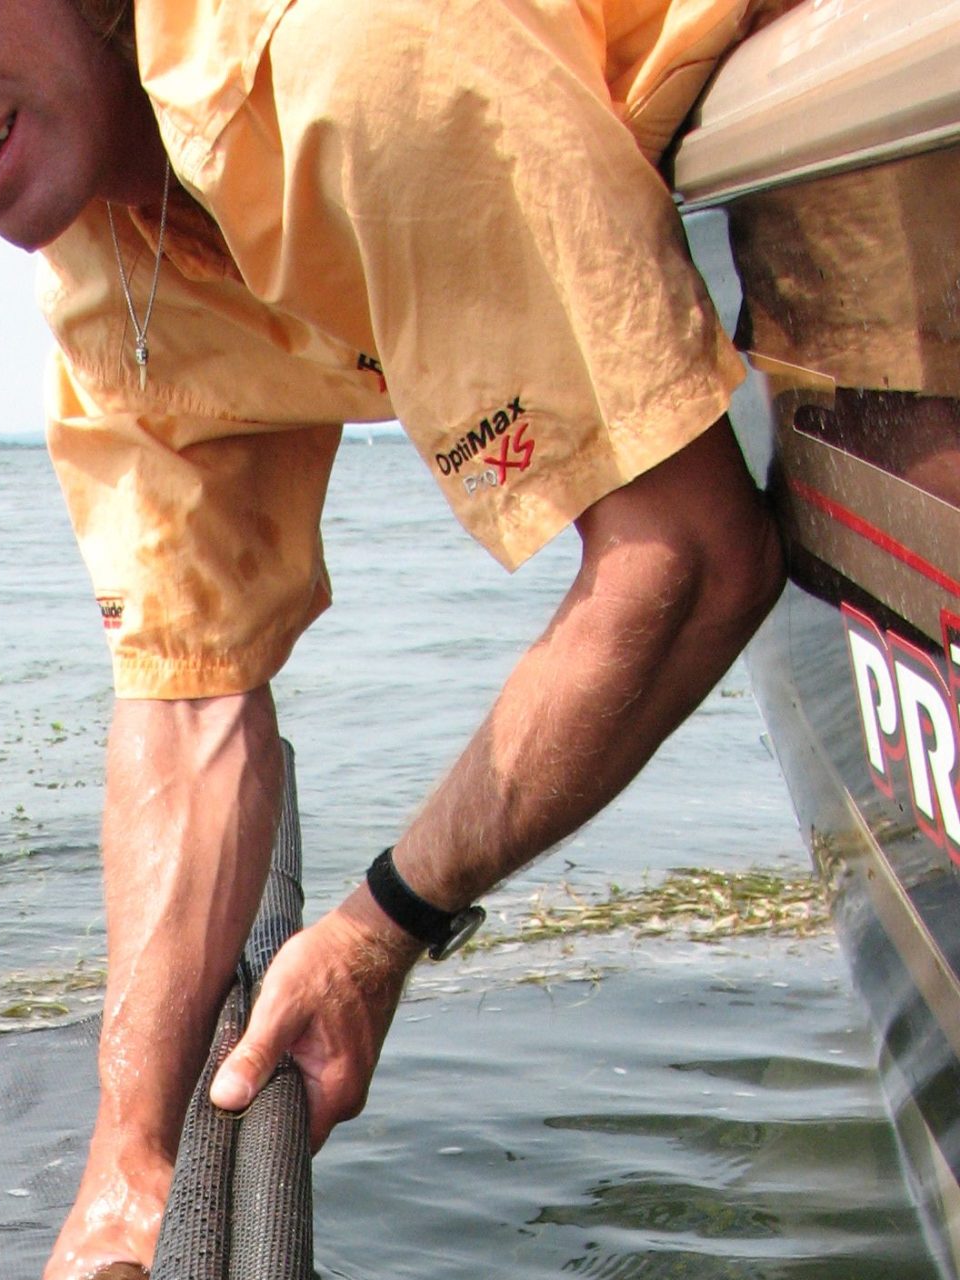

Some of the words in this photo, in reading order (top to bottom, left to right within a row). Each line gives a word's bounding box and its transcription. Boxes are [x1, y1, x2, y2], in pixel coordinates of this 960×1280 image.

[435, 396, 526, 476] OptiMax
[483, 422, 535, 485] XS
[848, 628, 960, 847] PR
